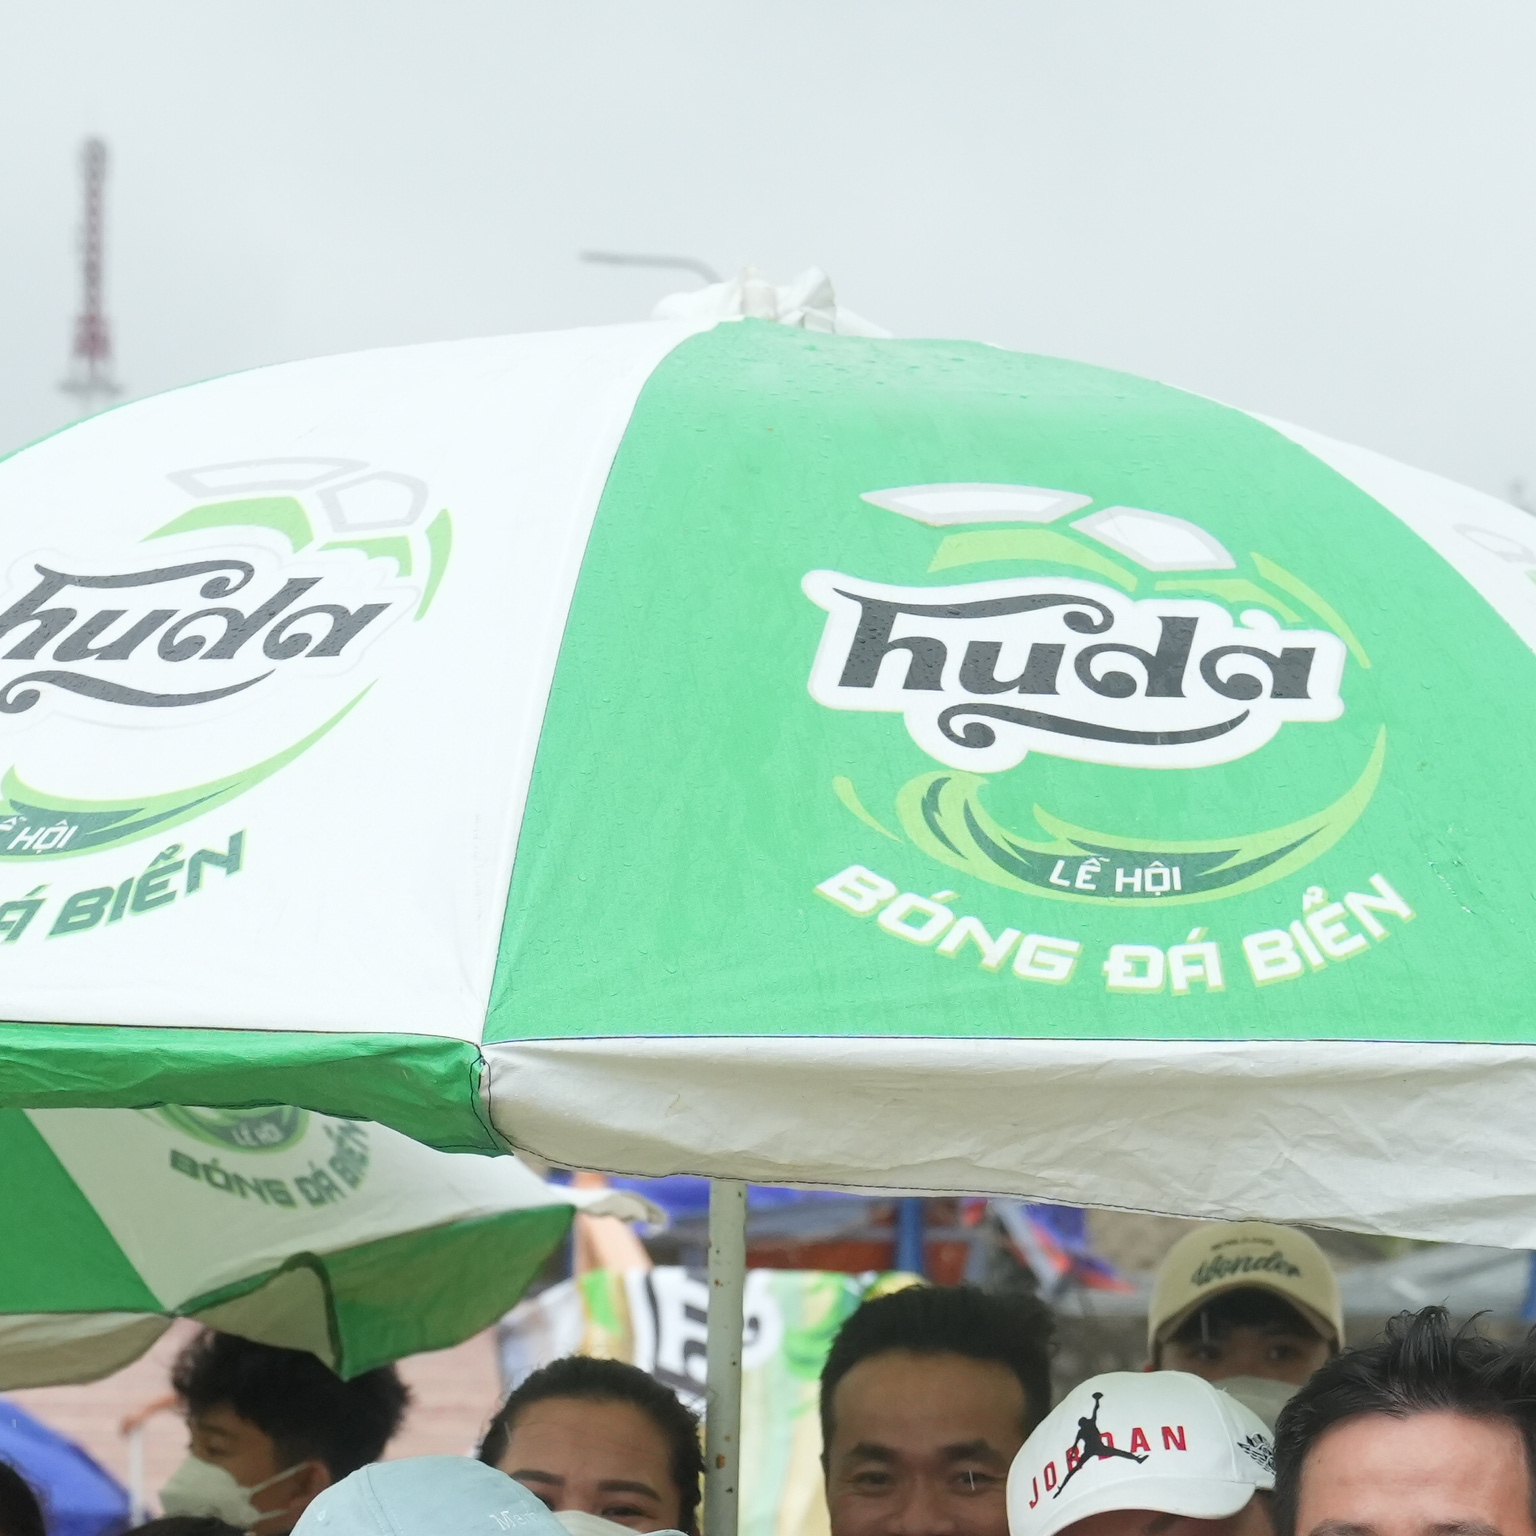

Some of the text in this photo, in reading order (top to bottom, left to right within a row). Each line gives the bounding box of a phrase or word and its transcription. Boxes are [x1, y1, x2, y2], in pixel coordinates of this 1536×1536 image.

[831, 586, 1316, 748] huda
[6, 820, 79, 855] HỘI
[46, 829, 246, 940] BIỂN
[1050, 857, 1181, 895] LỄ HỘI
[814, 864, 1416, 996] BÓNG ĐÁ BIỂN
[1029, 1426, 1187, 1508] JORDAN
